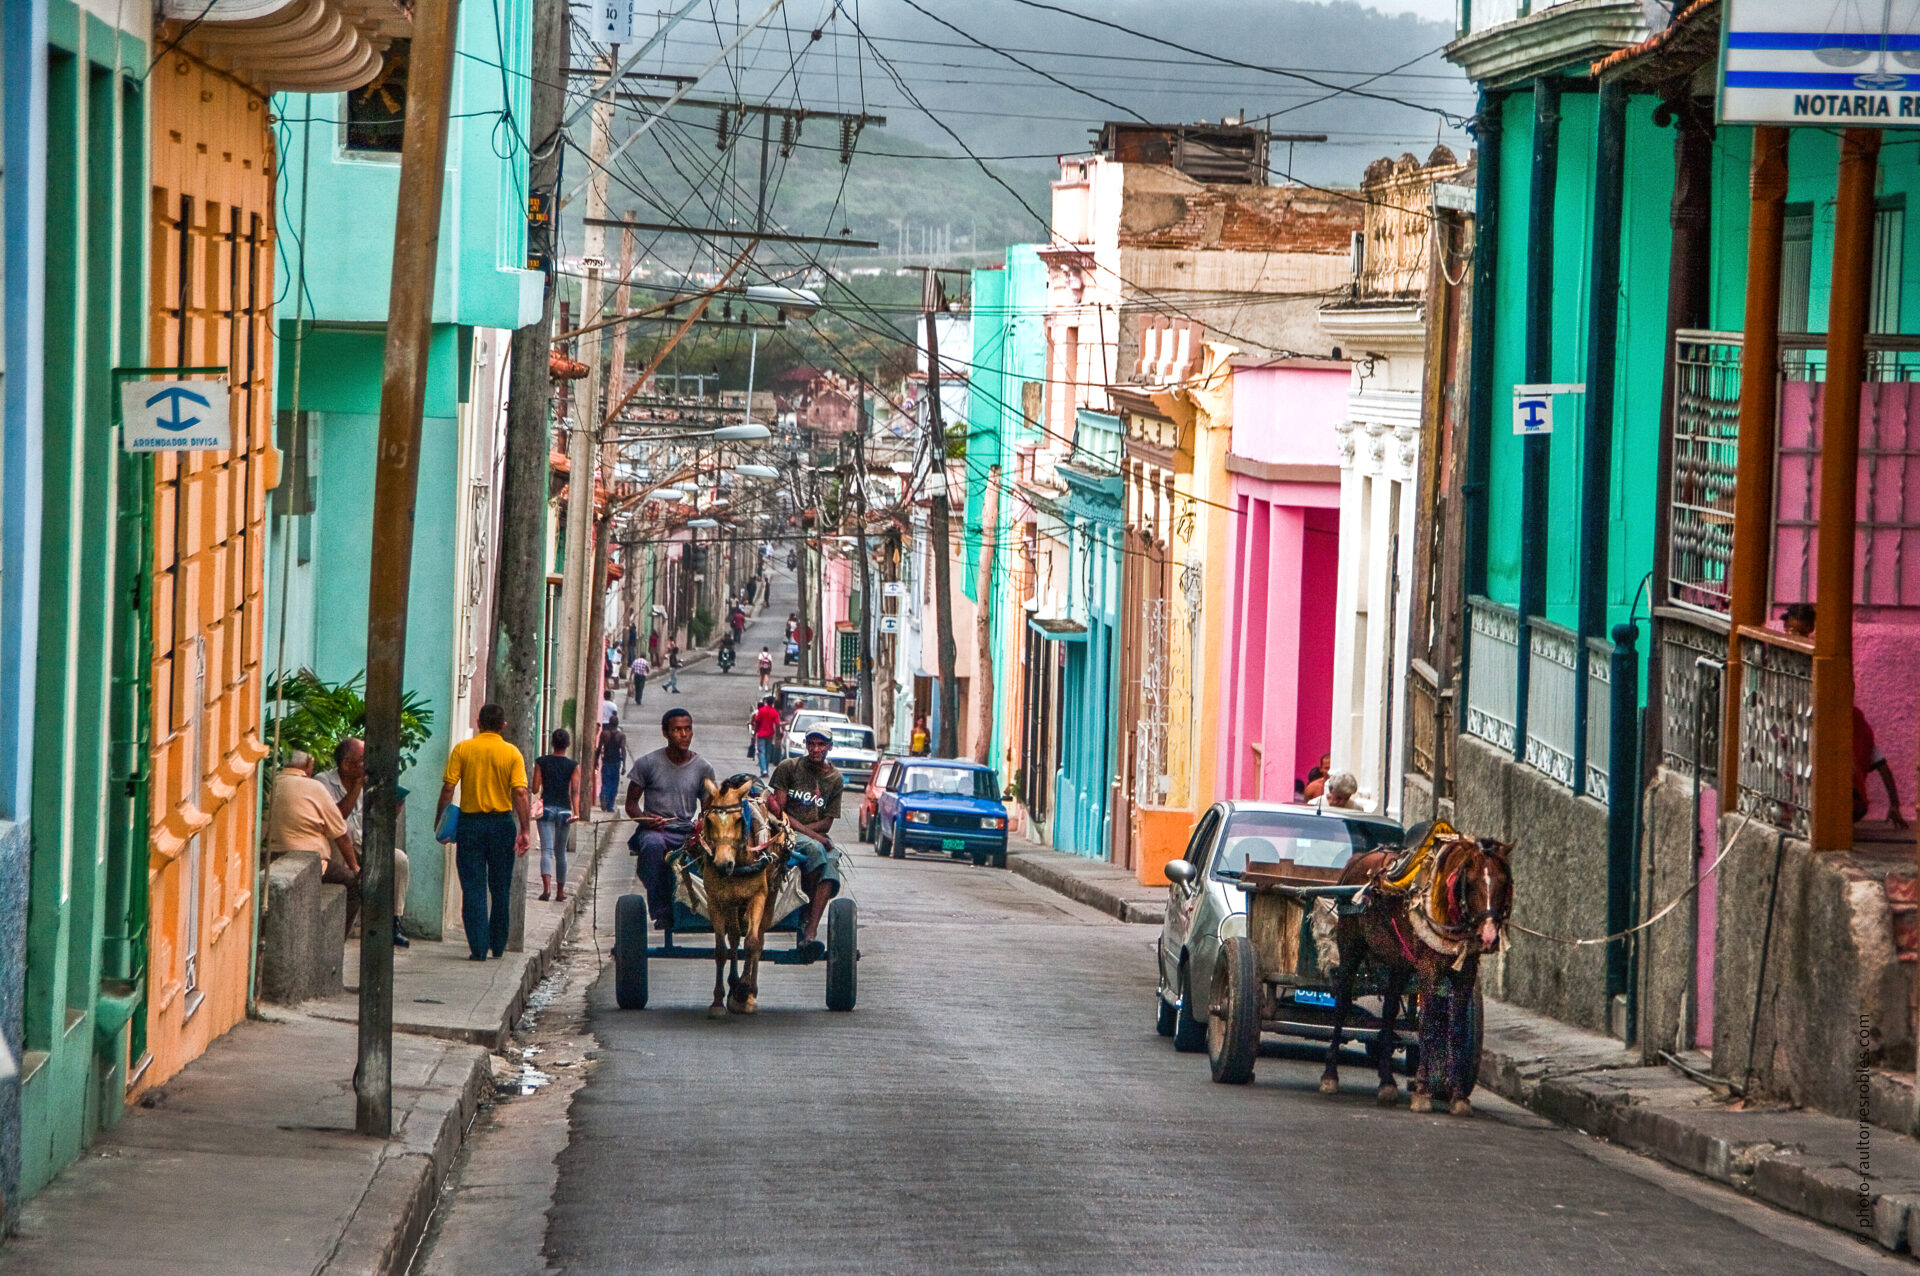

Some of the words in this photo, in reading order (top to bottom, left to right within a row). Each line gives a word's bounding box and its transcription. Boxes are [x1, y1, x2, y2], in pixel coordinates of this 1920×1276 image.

[1794, 94, 1891, 117] NOTARIA
[133, 438, 188, 448] ARRENDADOR
[191, 437, 219, 447] DIVISA
